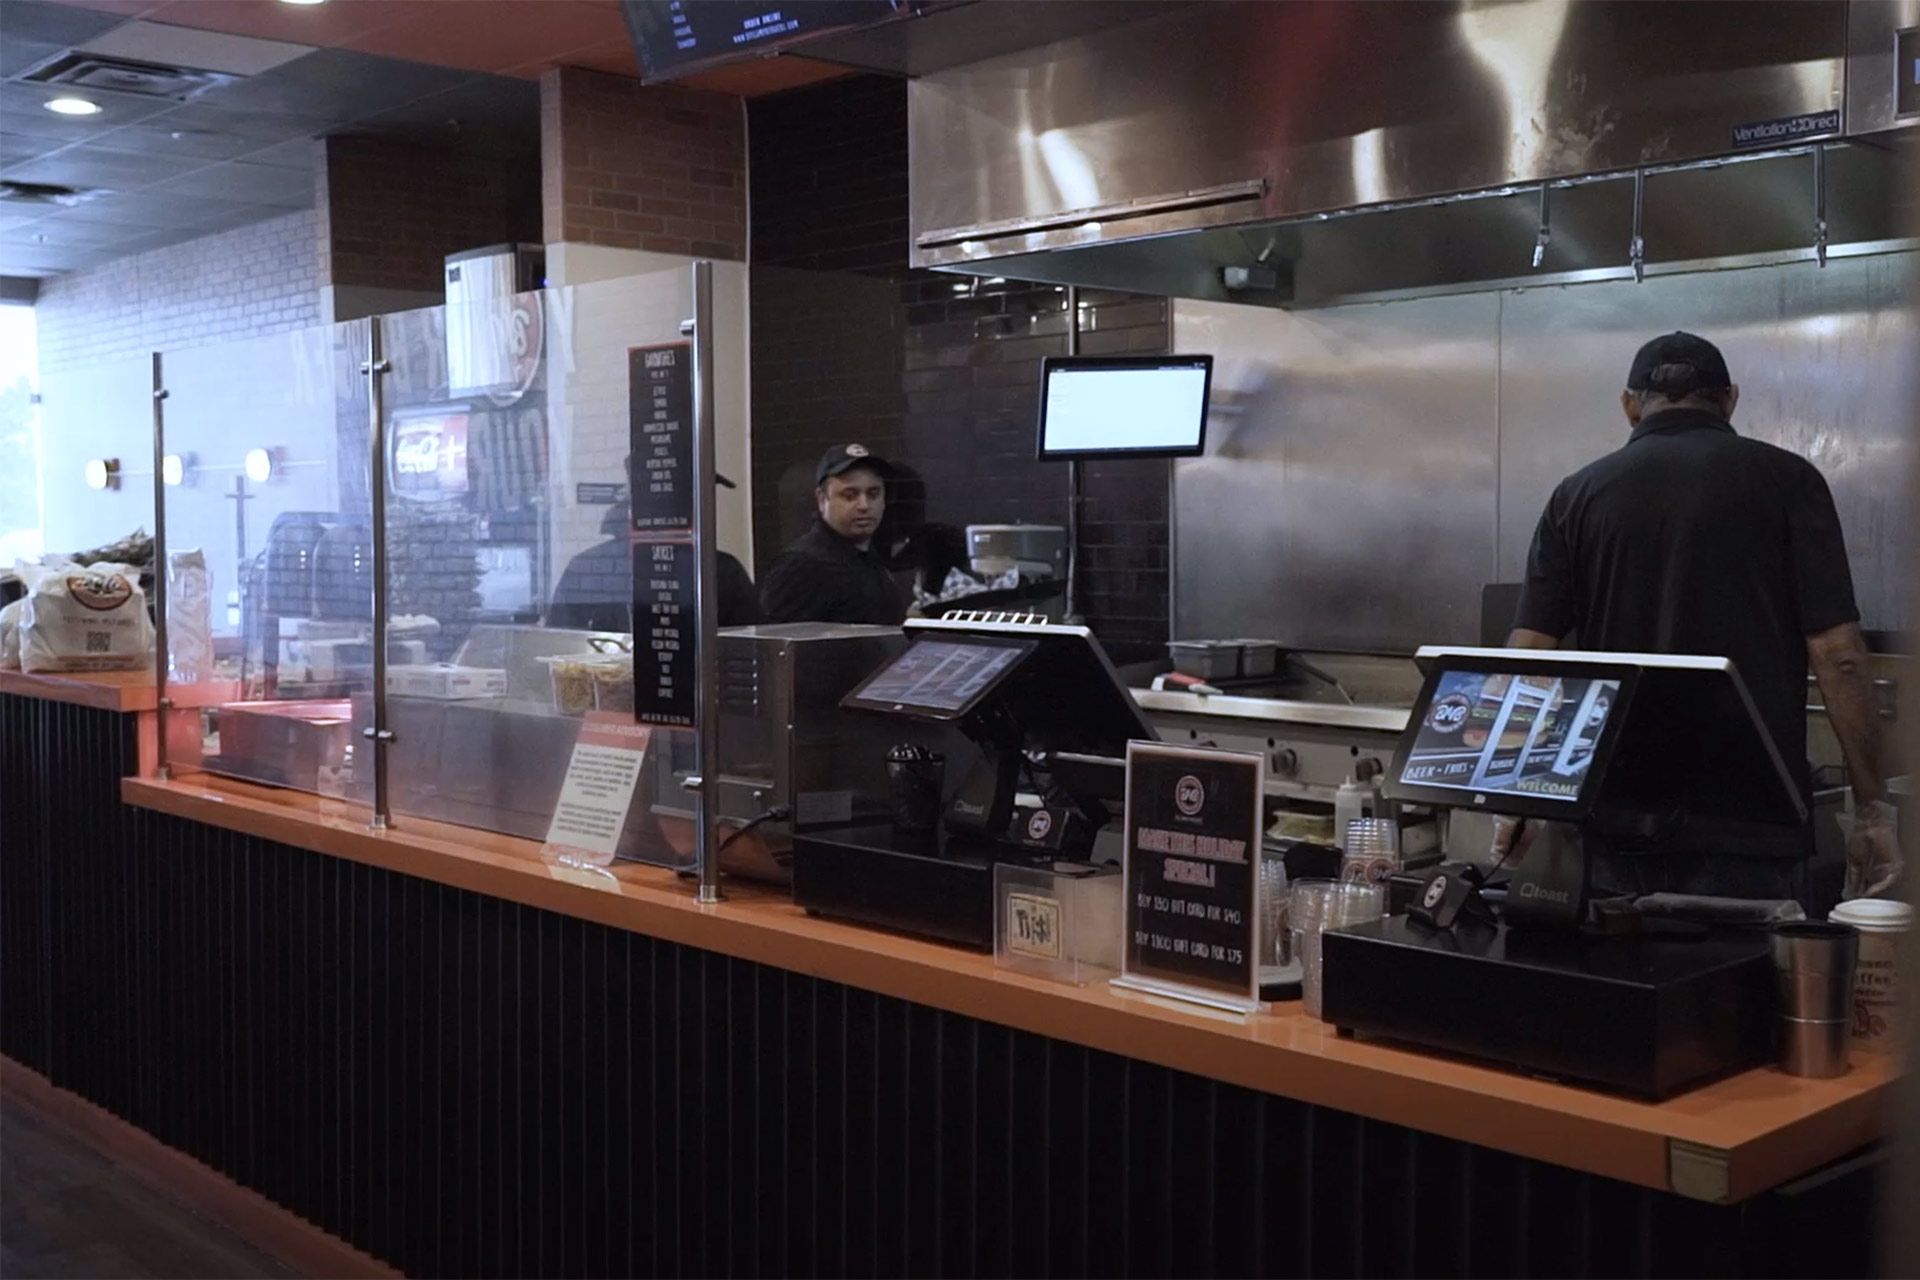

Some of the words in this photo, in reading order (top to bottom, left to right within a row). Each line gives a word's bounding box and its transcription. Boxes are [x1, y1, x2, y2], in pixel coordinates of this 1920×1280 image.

[1406, 765, 1434, 780] BEER
[1517, 780, 1579, 796] WELCOME
[1535, 887, 1569, 904] toast
[1171, 899, 1185, 914] GIFT
[1187, 902, 1206, 918] CARD
[1208, 905, 1221, 921] FOR
[1224, 908, 1241, 925] $40
[1174, 938, 1189, 954] GIFT
[1191, 941, 1210, 958] CARD
[1211, 945, 1225, 961] FOR
